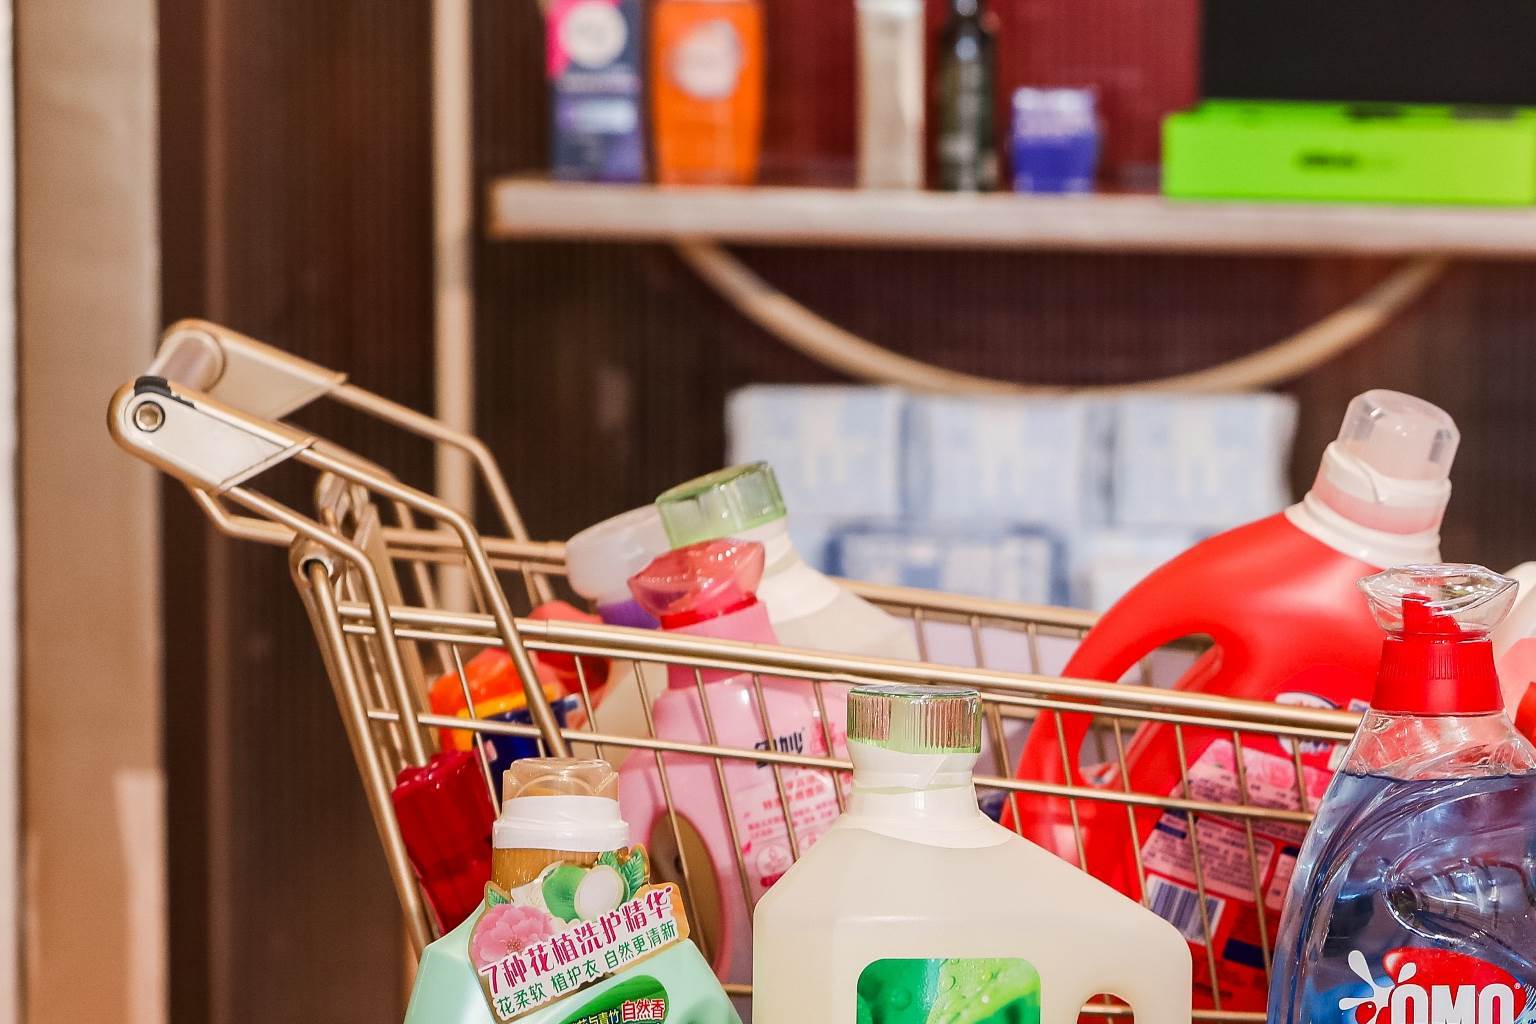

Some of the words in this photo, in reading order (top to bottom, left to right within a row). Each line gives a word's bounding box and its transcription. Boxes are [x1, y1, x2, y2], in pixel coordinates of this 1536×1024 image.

[480, 890, 672, 995] 7种花植洗护精华
[496, 983, 545, 1016] 花柔软
[552, 958, 600, 994] 植护衣
[606, 921, 677, 969] 自然更清新
[622, 998, 665, 1022] 自然香
